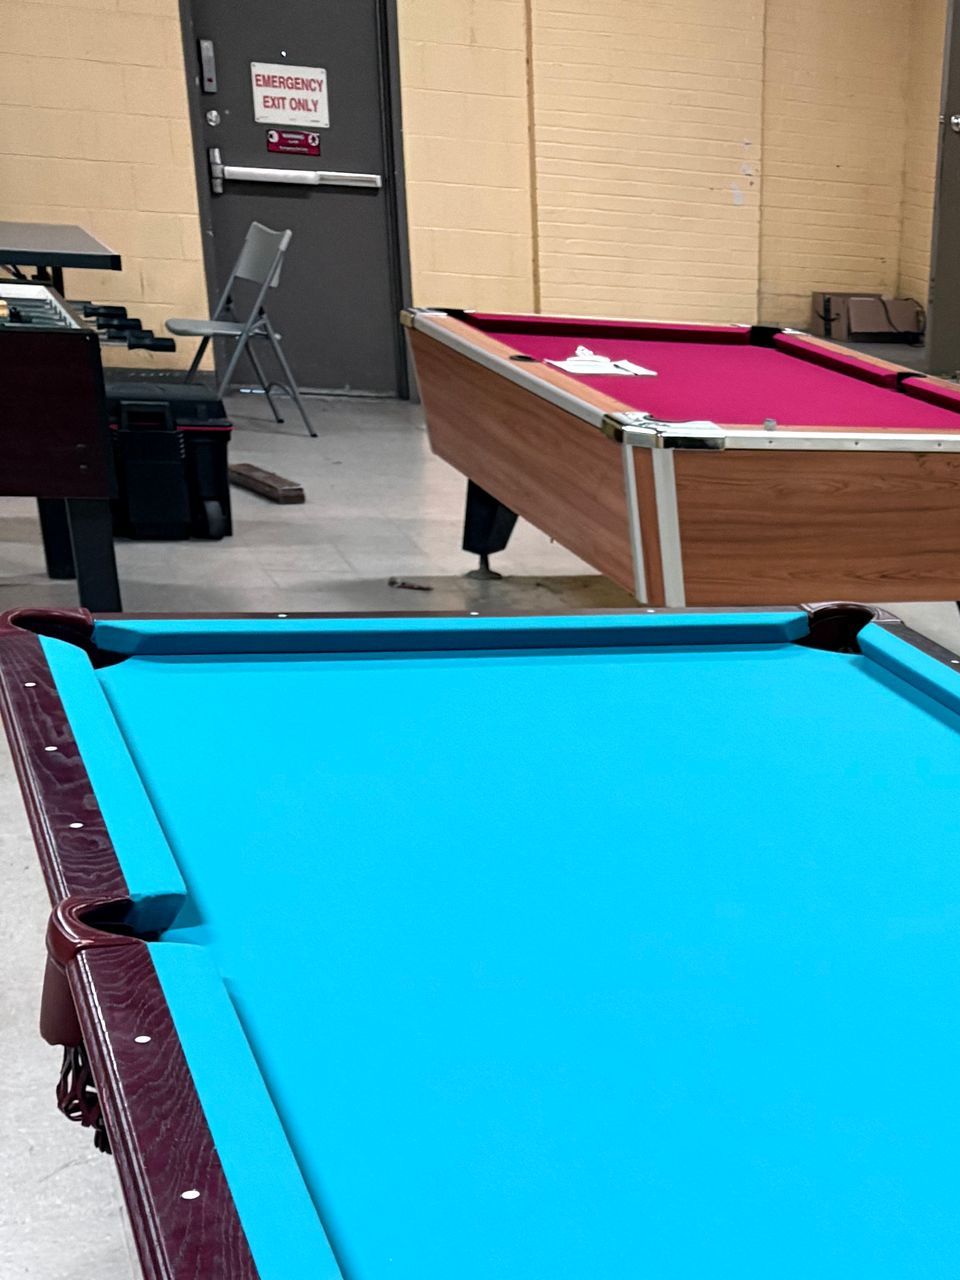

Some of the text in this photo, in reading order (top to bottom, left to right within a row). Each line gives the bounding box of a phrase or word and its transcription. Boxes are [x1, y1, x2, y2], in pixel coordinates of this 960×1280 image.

[255, 74, 323, 92] EMERGENCY
[263, 95, 318, 112] EXIT ONLY
